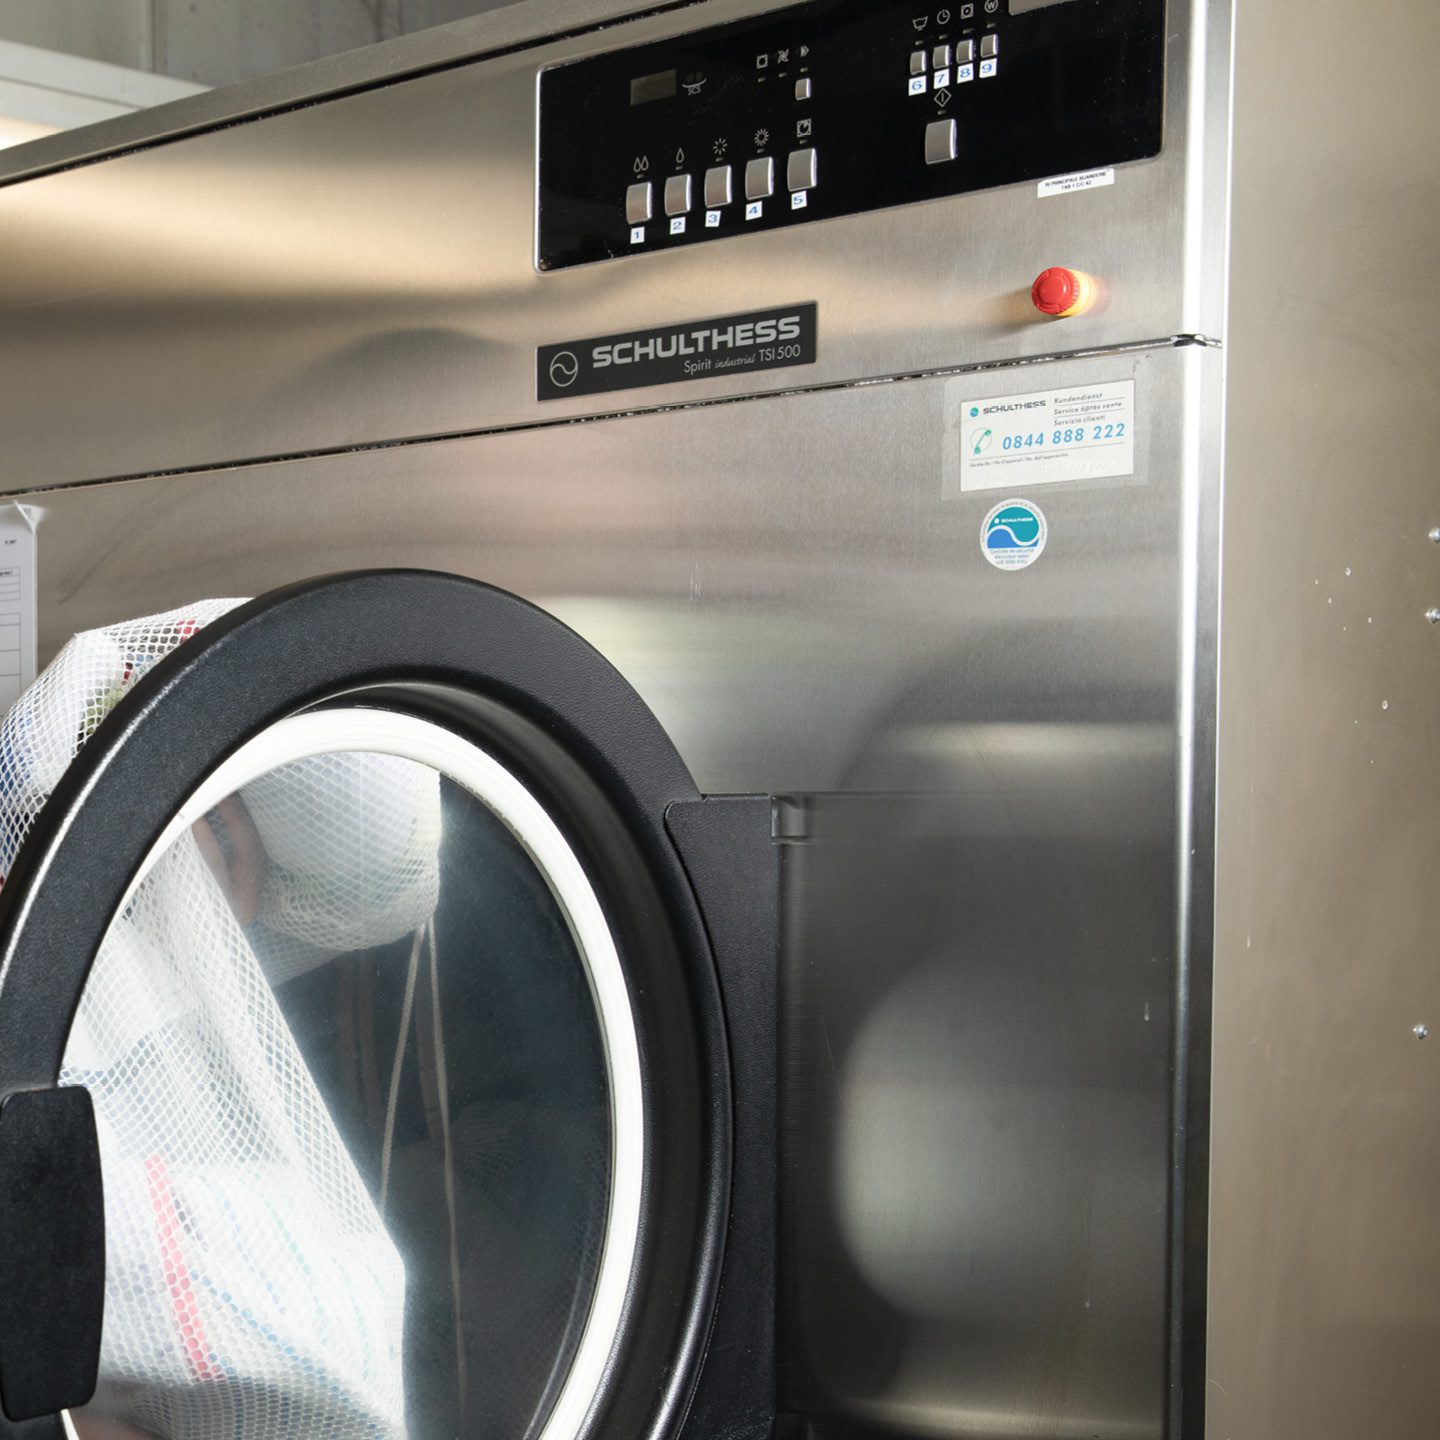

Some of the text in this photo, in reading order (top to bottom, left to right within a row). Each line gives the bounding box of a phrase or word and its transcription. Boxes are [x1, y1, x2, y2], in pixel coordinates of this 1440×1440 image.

[912, 63, 992, 90] 6 7 8 9
[672, 221, 682, 231] 2
[707, 214, 718, 223] 3
[748, 206, 758, 215] 4
[793, 196, 803, 205] 5
[592, 315, 800, 368] SCHULTHESS
[683, 359, 712, 375] Spirit
[714, 353, 757, 369] industrial
[983, 400, 1047, 415] SCHULTHESS
[1053, 393, 1103, 404] Kundendienst
[1053, 407, 1079, 416] Service
[1053, 414, 1106, 427] Servizio clienti
[1002, 423, 1126, 450] 0844 888 222
